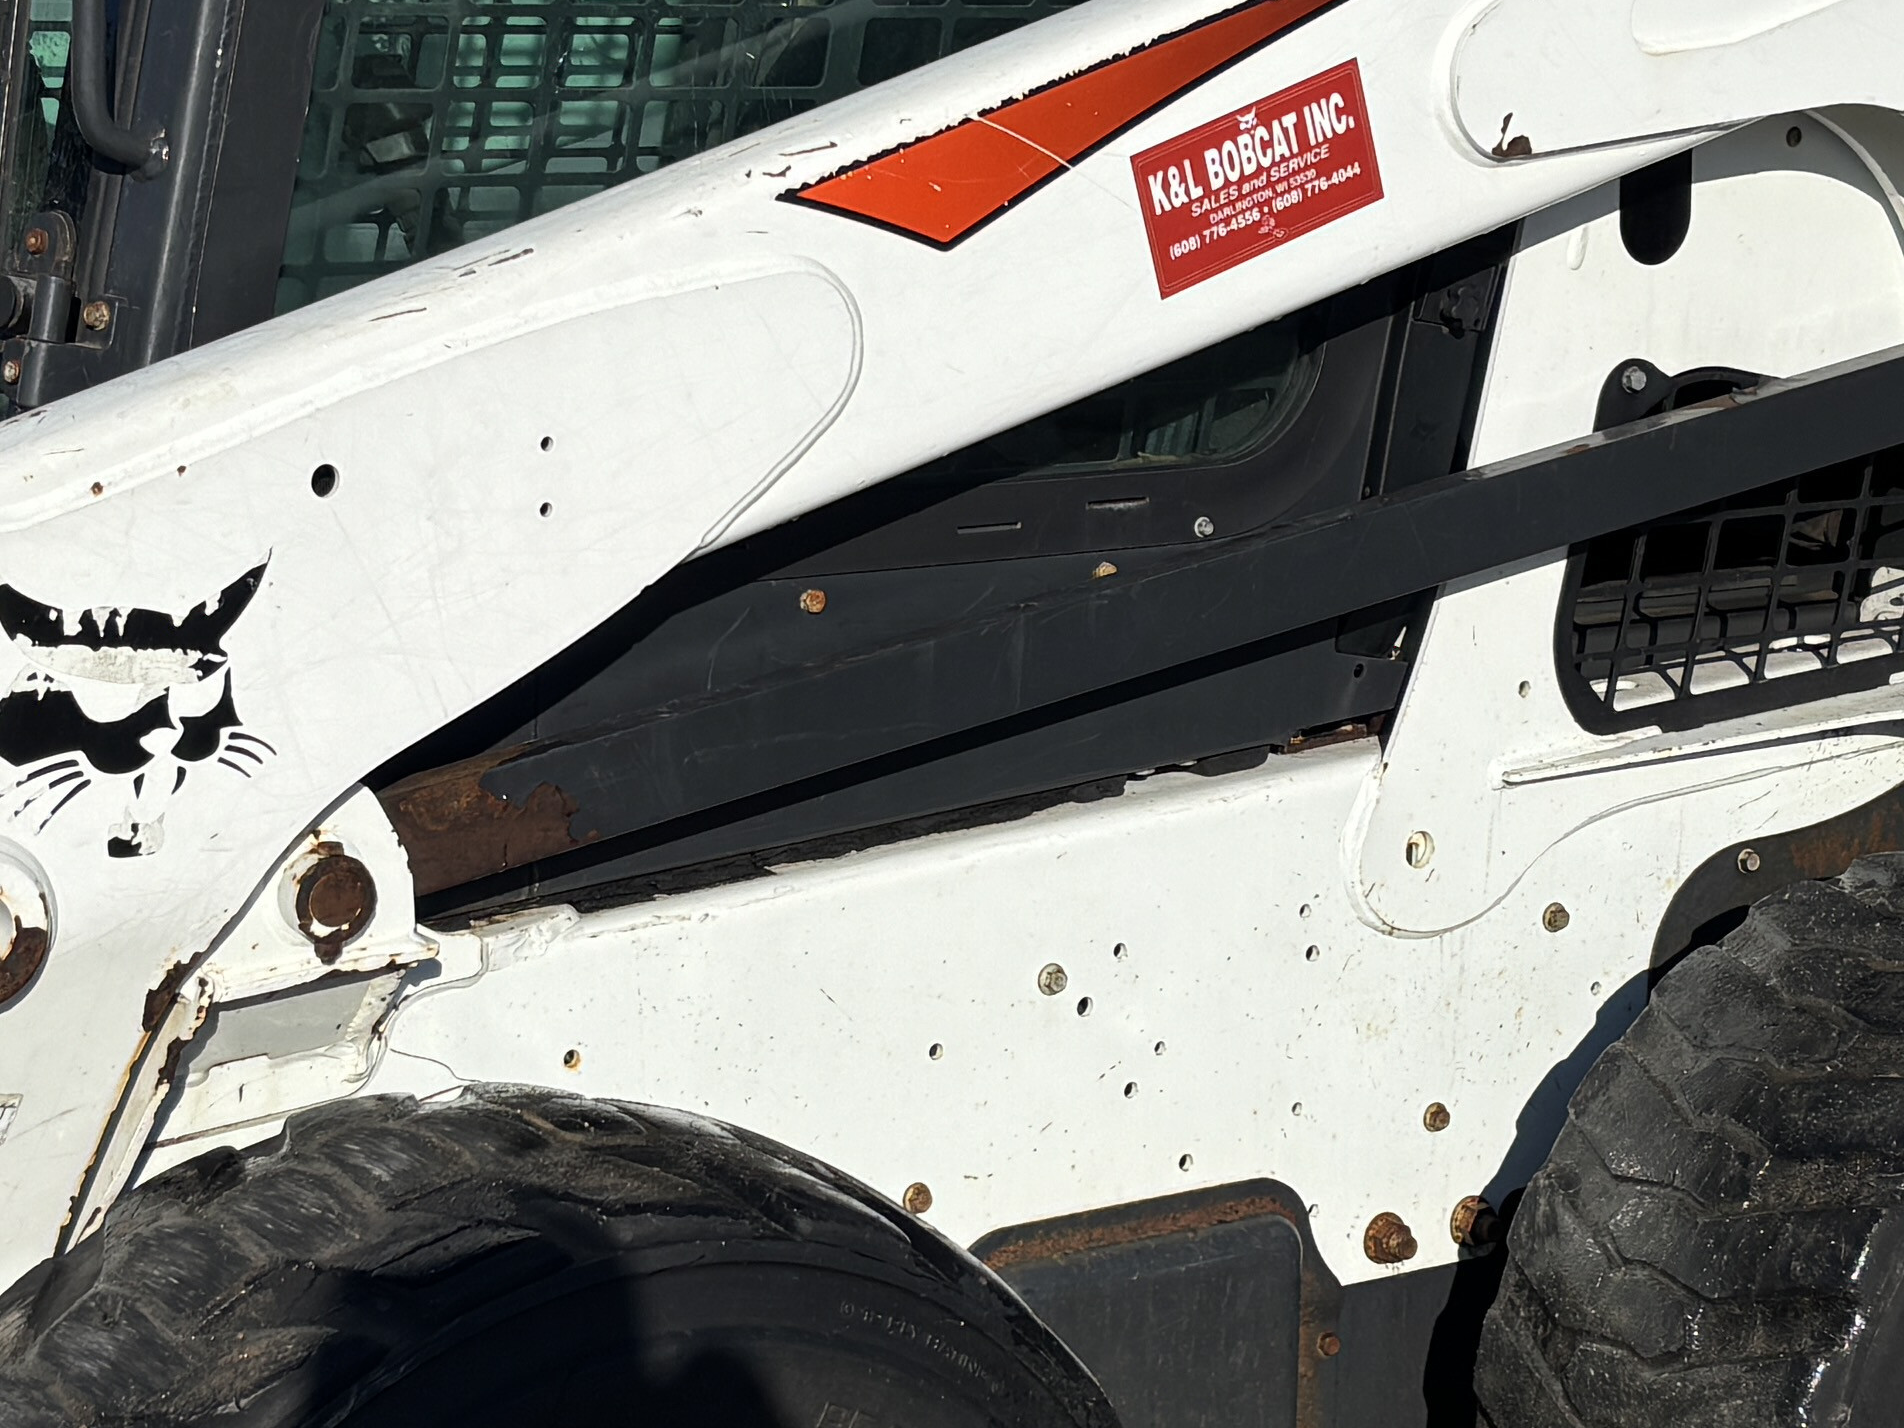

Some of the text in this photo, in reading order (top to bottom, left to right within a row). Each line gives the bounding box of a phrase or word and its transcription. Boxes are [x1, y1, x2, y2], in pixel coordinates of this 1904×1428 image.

[1148, 92, 1355, 215] K&L BOBCAT INC.
[1191, 143, 1330, 217] SALES and SERVICE
[1169, 161, 1361, 260] (608) 776-4556 (608) 776-4044
[1209, 190, 1275, 224] DARLINGTON,
[1276, 180, 1289, 194] WI
